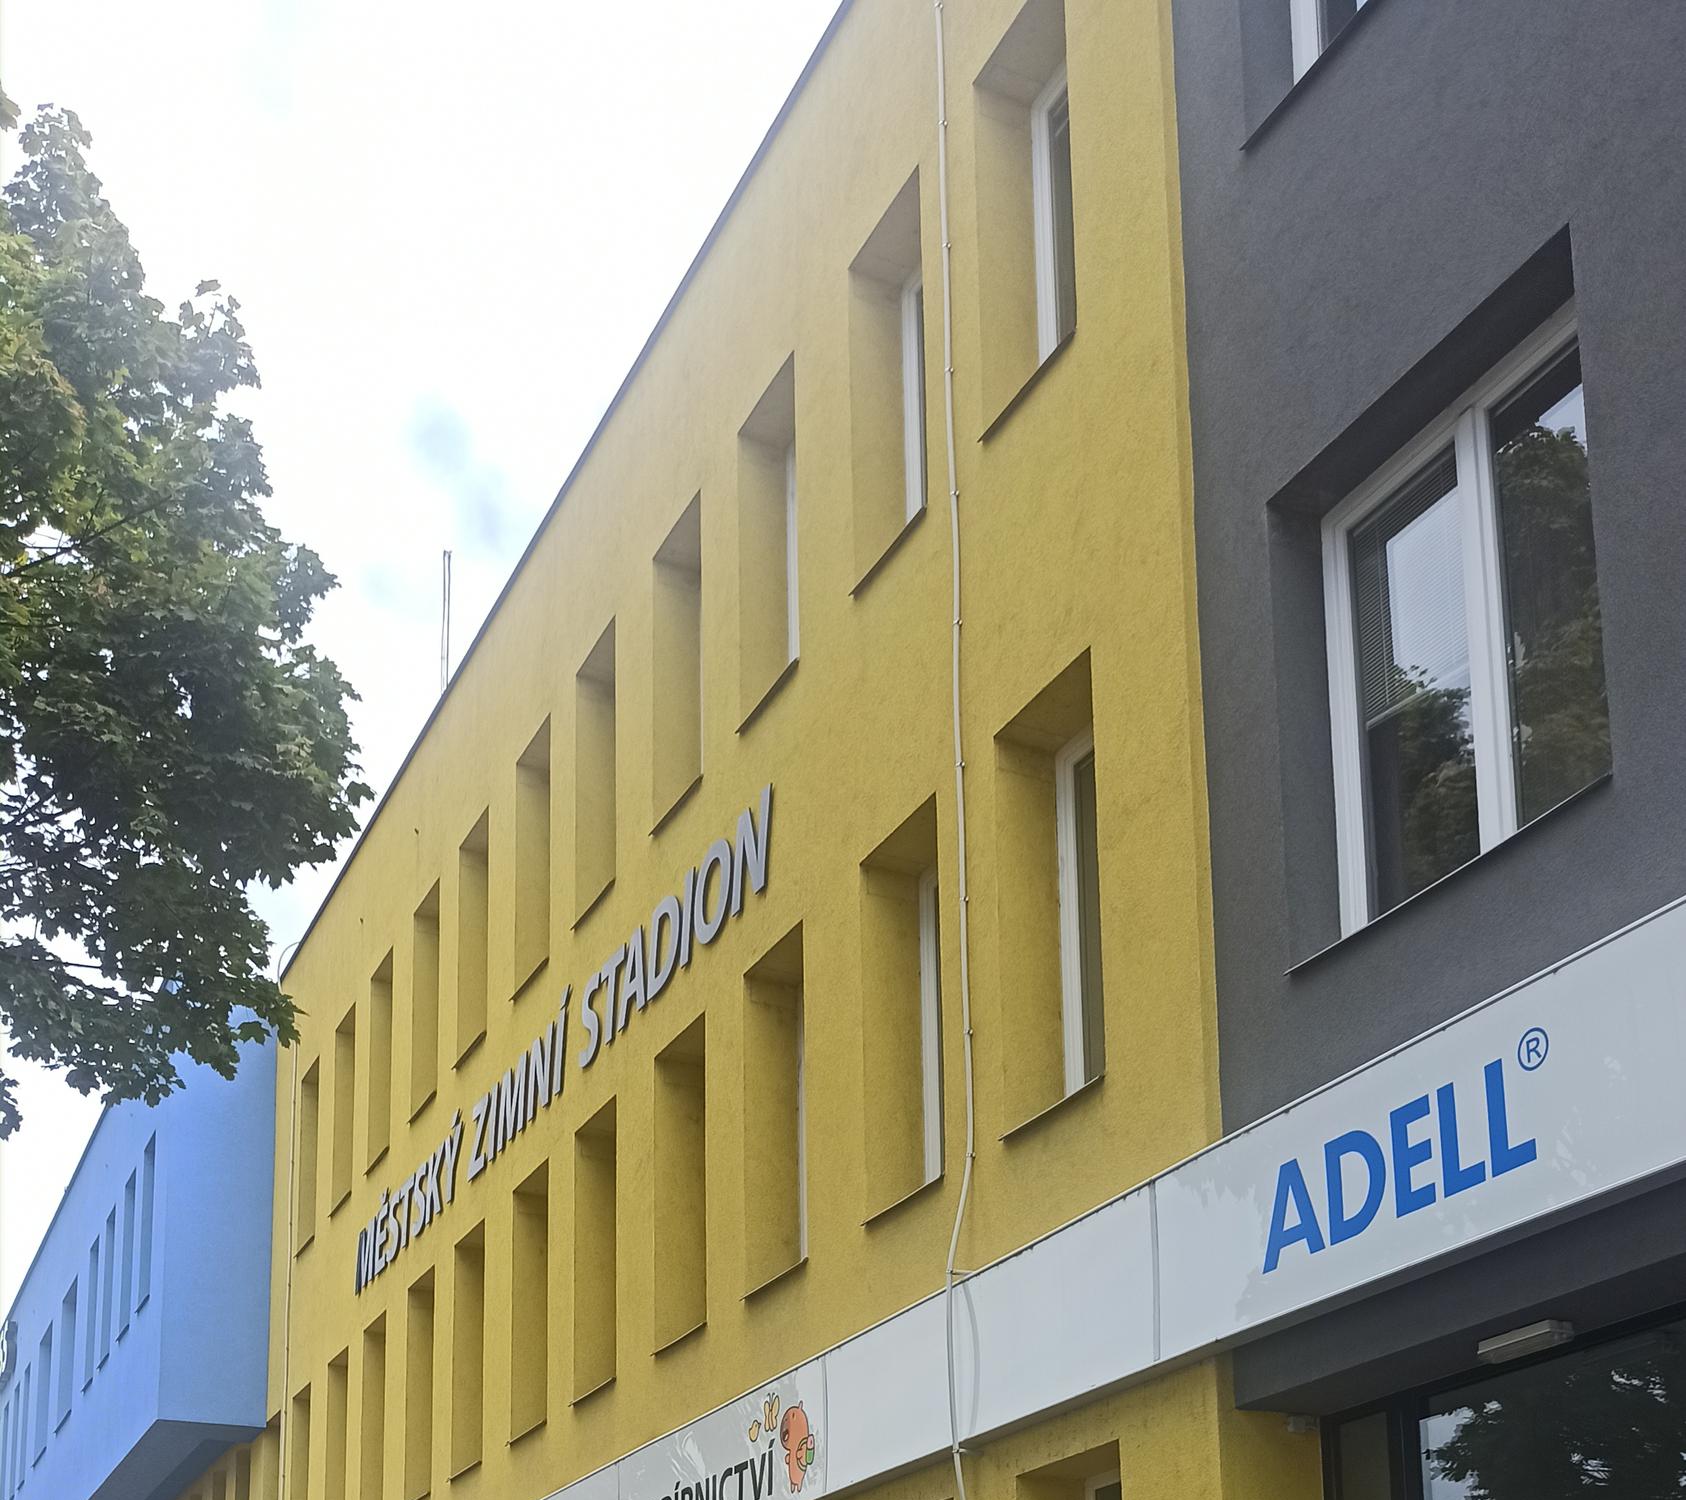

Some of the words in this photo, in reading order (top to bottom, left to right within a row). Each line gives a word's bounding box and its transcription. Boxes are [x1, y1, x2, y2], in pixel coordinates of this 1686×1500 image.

[355, 1108, 466, 1295] MĚSTSKÝ
[466, 983, 572, 1184] ZIMNÍ
[579, 782, 774, 1069] STADION
[1262, 1057, 1538, 1275] ADELL
